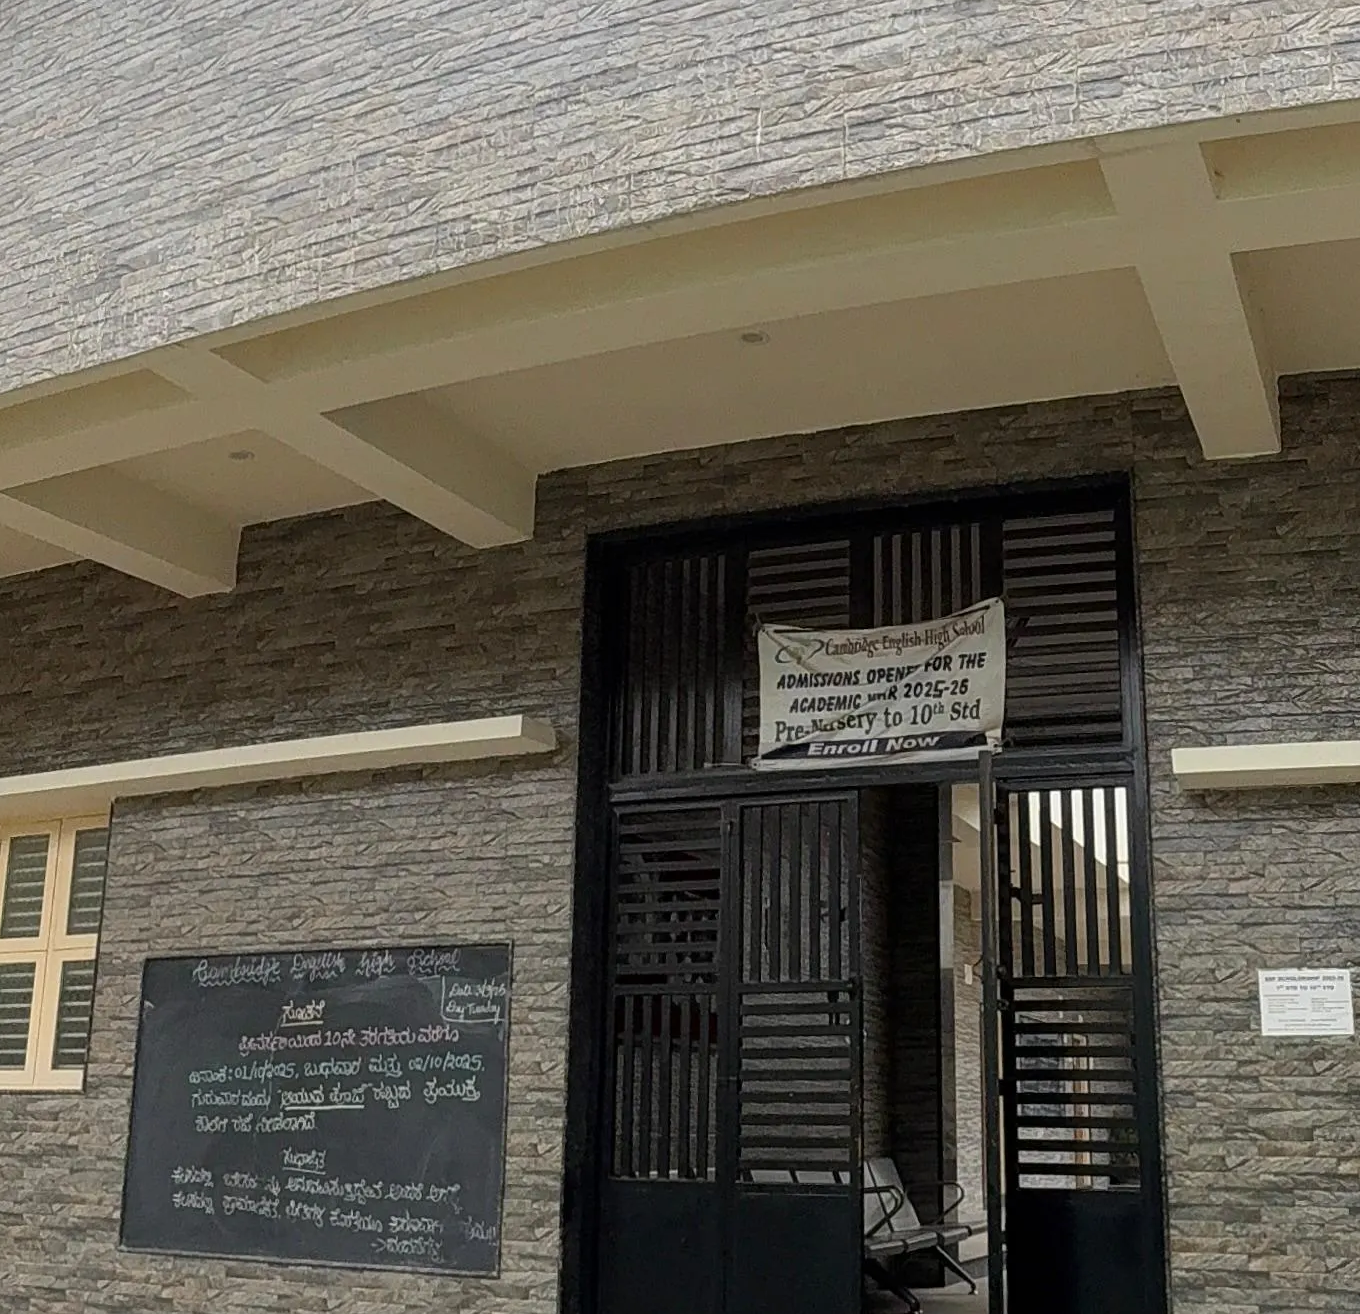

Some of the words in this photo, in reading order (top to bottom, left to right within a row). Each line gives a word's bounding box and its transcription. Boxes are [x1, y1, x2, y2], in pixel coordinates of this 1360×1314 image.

[882, 630, 921, 655] English
[924, 627, 950, 648] High
[777, 670, 860, 690] ADMISSIONS
[959, 652, 987, 670] THE
[790, 694, 862, 714] ACADEMIC
[903, 678, 969, 699] 2025-26
[883, 706, 903, 728] to
[909, 701, 945, 726] 10th
[949, 699, 981, 722] Std
[807, 738, 878, 756] Enroll
[885, 736, 941, 752] Now
